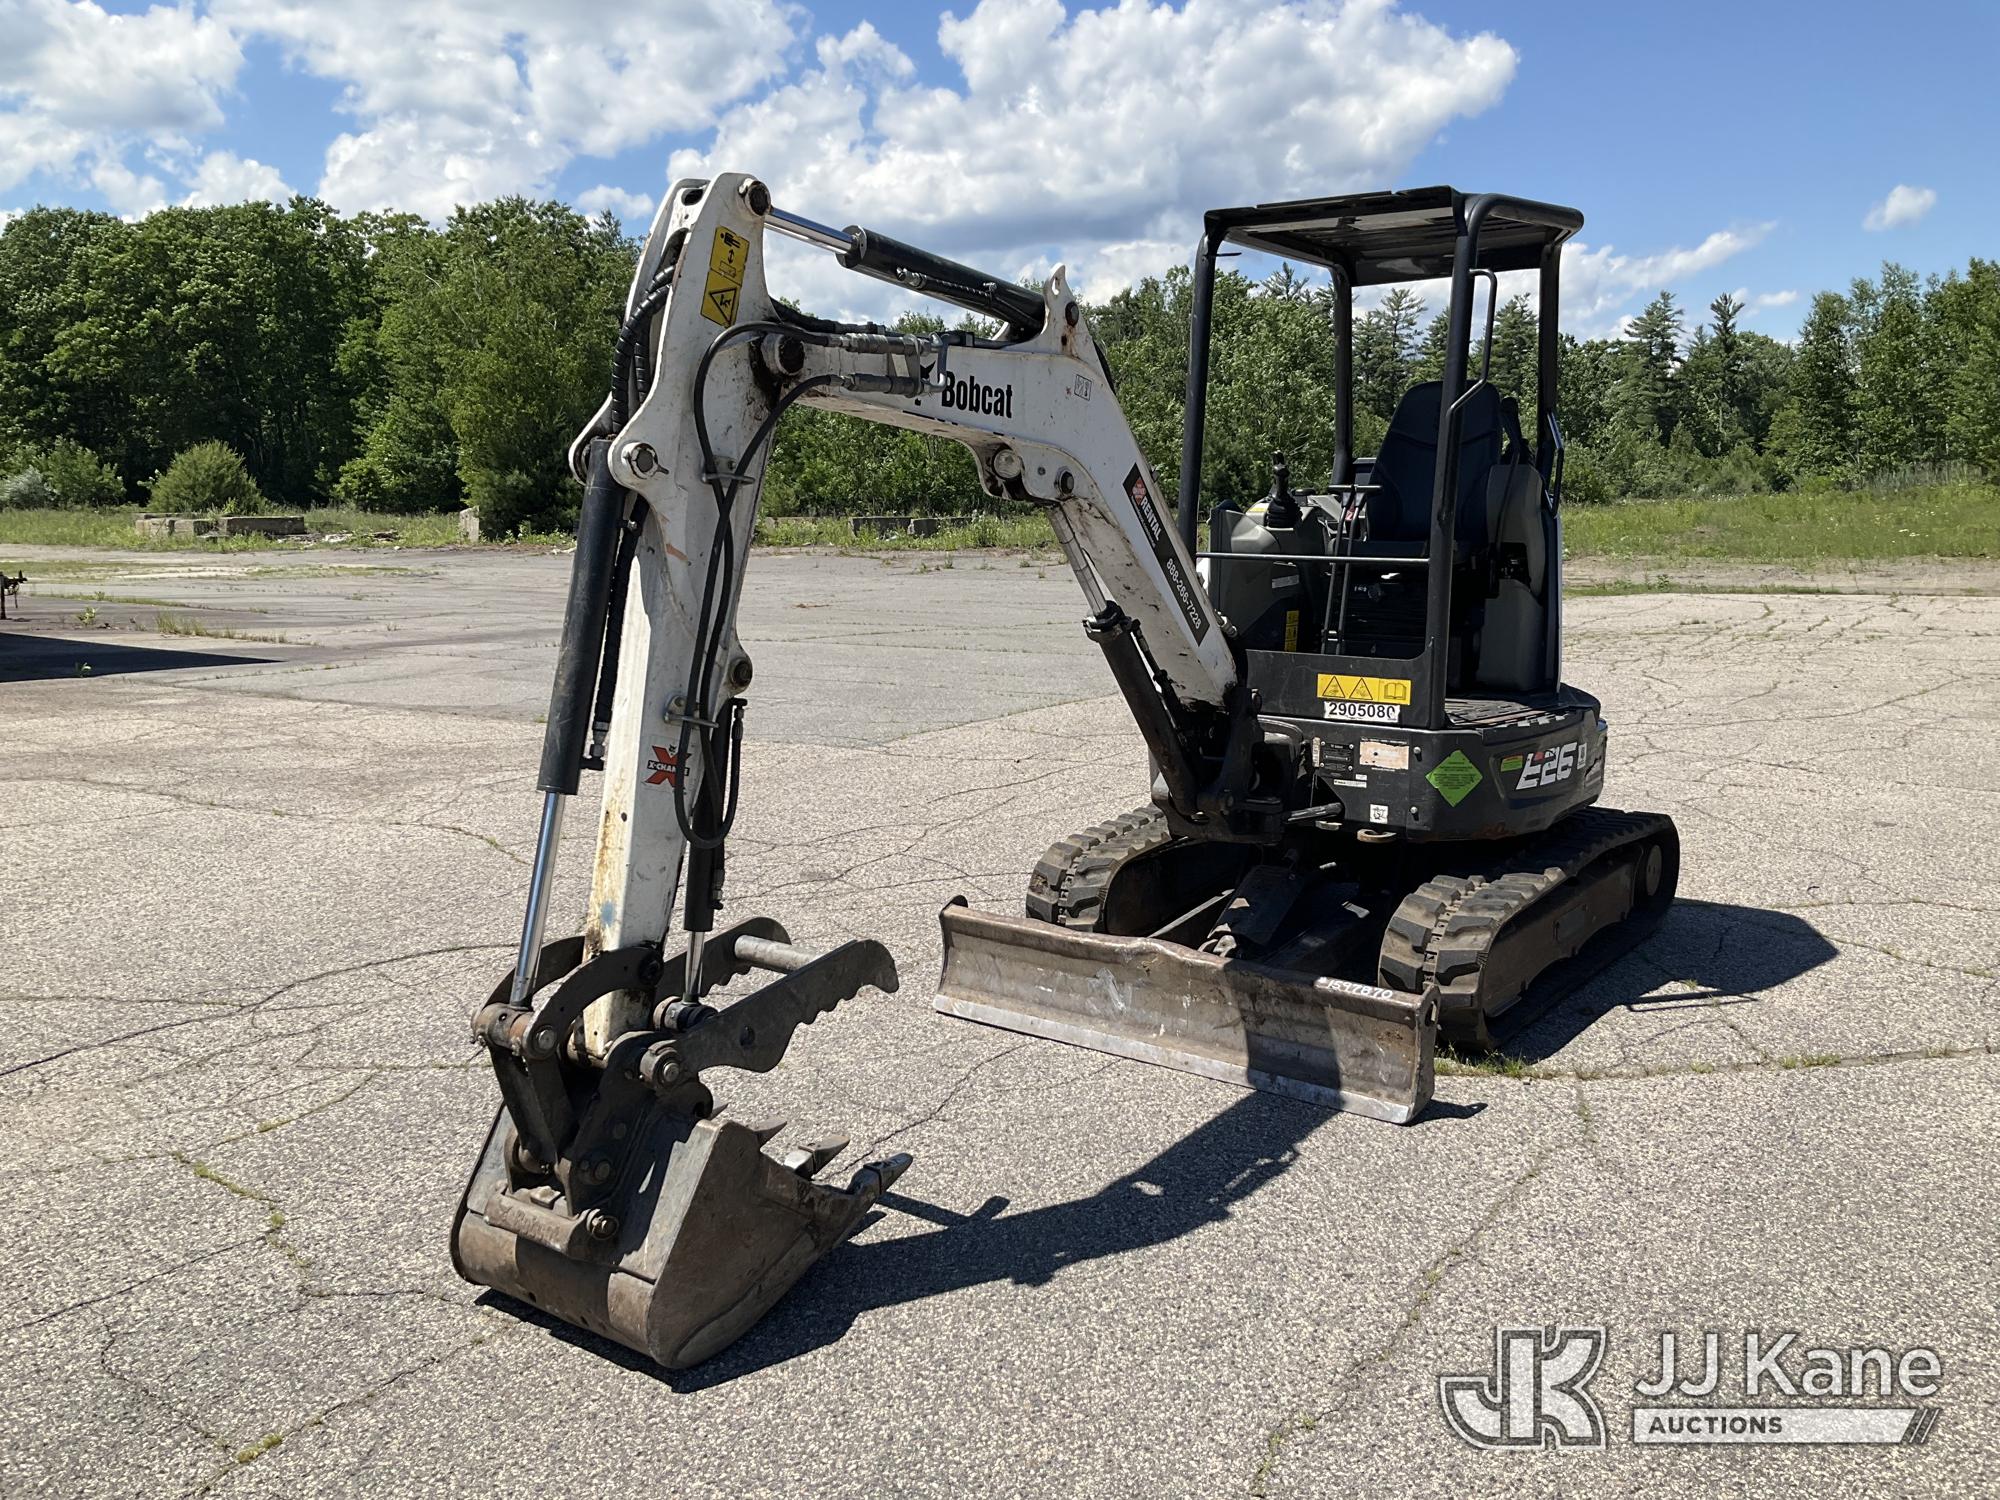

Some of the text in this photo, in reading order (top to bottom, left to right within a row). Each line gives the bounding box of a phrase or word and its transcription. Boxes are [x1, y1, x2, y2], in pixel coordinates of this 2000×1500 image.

[942, 370, 1012, 418] Bobcat
[1141, 496, 1161, 541] RENTAL
[1166, 558, 1201, 630] 888-266-7228
[648, 760, 689, 776] X-CHANE
